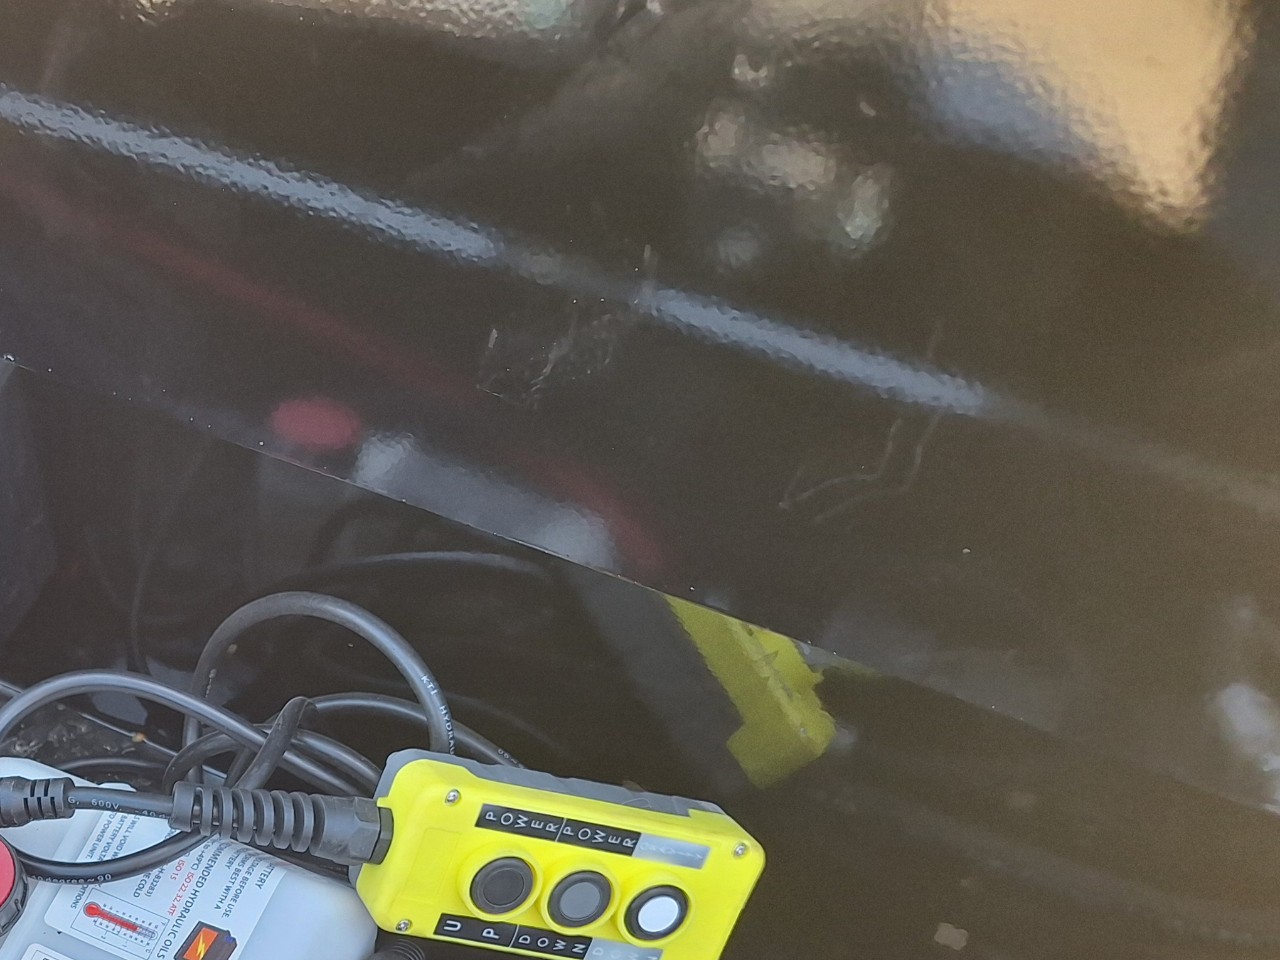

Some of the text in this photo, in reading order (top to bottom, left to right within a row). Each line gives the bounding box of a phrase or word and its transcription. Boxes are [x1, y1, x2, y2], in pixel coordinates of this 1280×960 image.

[419, 674, 437, 696] KTI
[93, 817, 111, 843] POWER
[105, 813, 128, 842] BATTERY
[123, 818, 138, 834] WILL
[484, 808, 560, 835] POWER
[561, 823, 637, 849] POWER
[85, 841, 98, 859] UNIT.
[114, 832, 129, 851] VOID
[169, 858, 185, 880] ISO 15
[183, 871, 195, 884] ISO
[227, 867, 241, 885] BEST
[132, 877, 147, 898] COLD
[217, 884, 232, 904] WITH
[229, 875, 249, 903] BEFORE
[166, 902, 178, 916] ATF
[166, 887, 201, 939] HYDRAULIC
[213, 903, 222, 911] A
[221, 902, 235, 920] USE.
[443, 919, 501, 940] UP
[518, 932, 586, 955] DOWN
[156, 938, 174, 960] OILS
